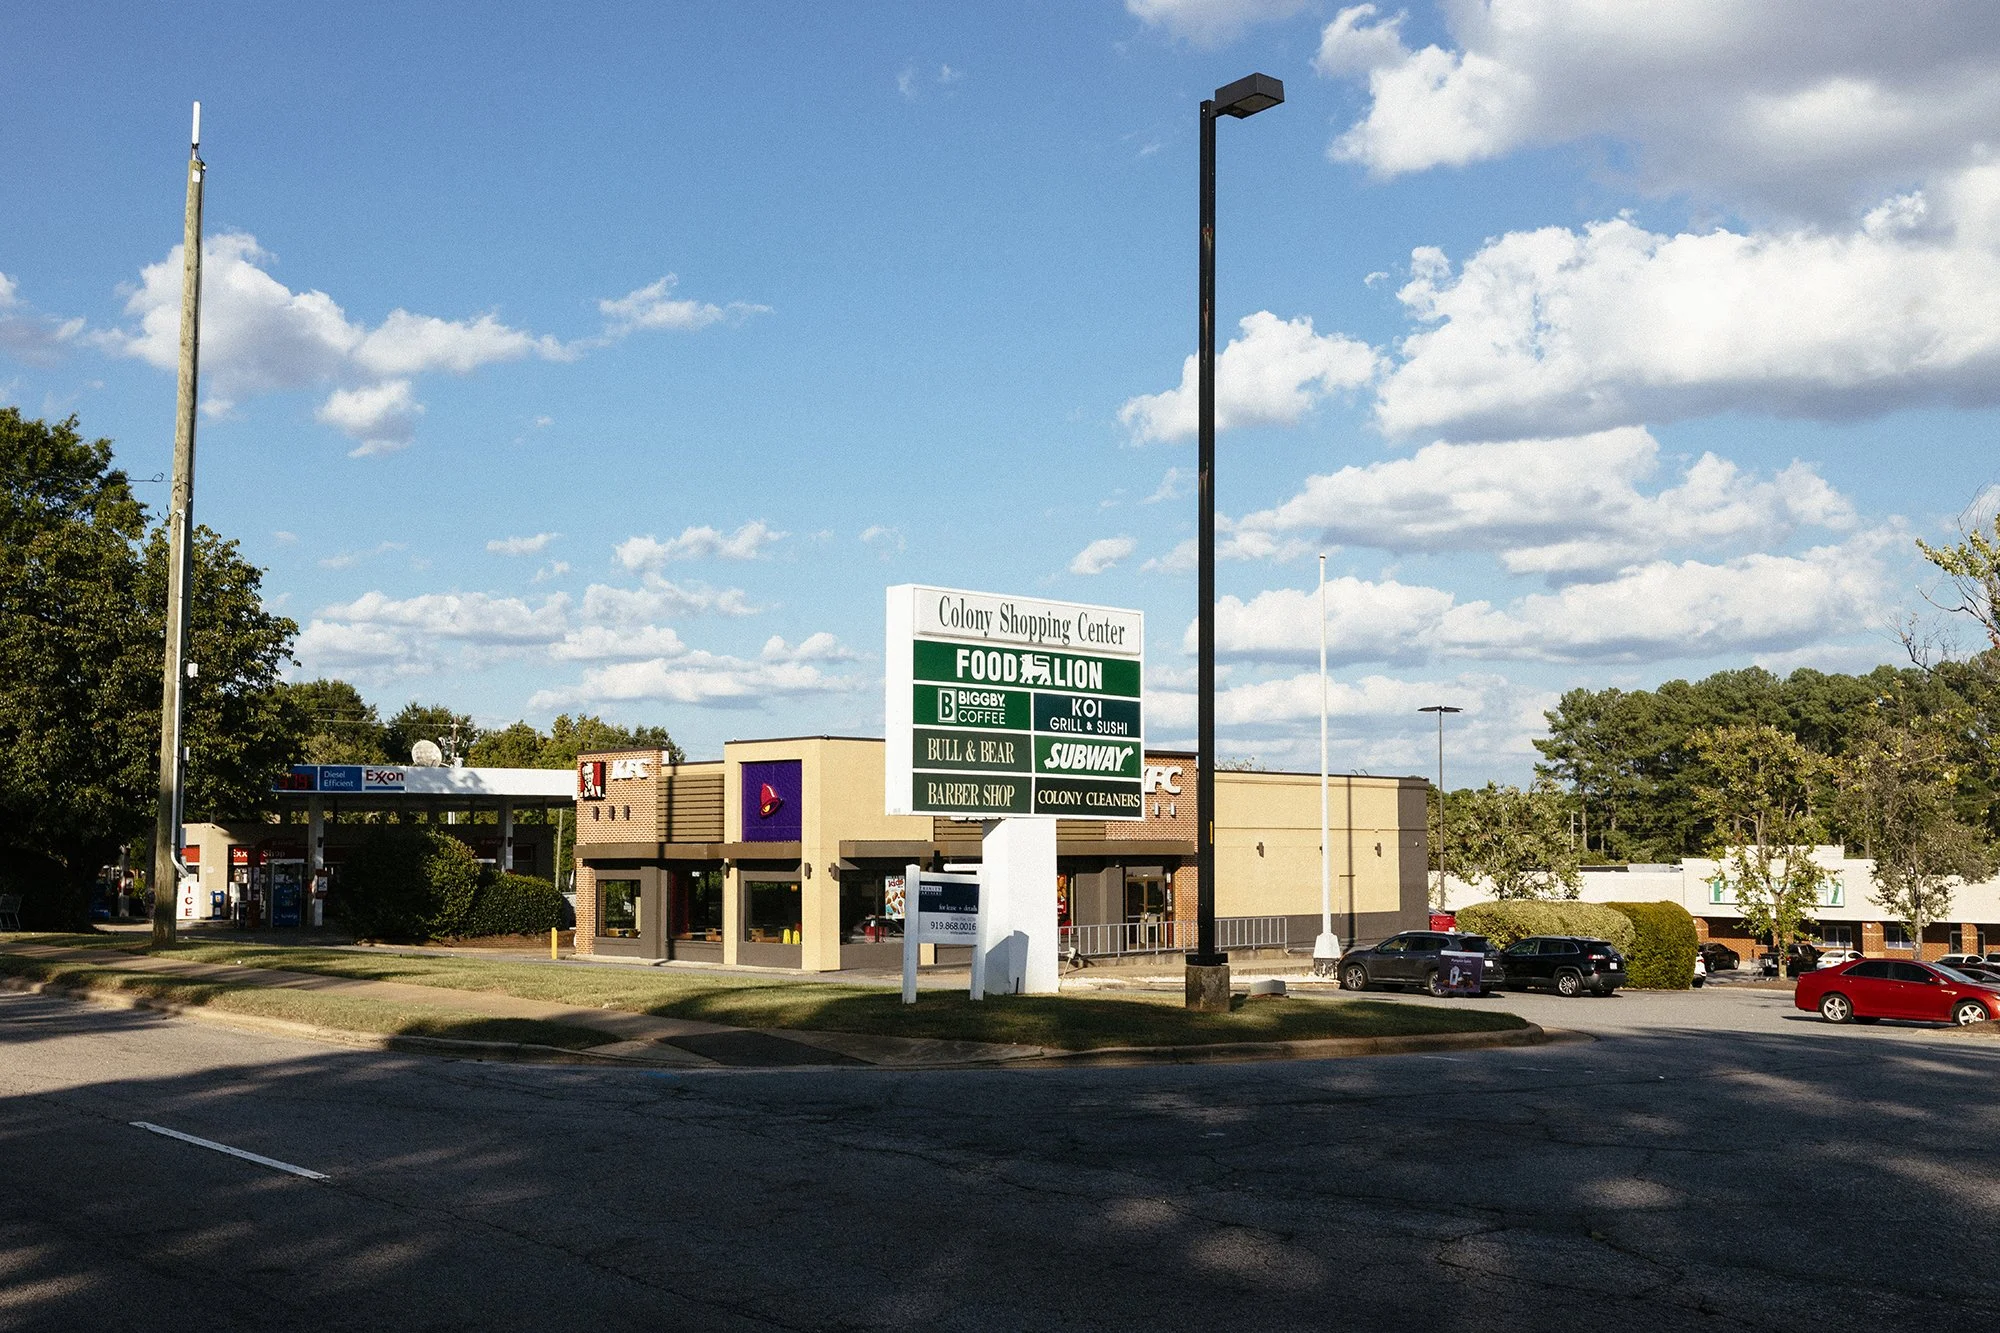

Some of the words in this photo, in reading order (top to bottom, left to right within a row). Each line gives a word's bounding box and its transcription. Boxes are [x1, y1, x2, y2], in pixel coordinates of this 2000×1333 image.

[939, 595, 993, 638] Colony
[1000, 602, 1072, 645] Shopping
[1078, 611, 1125, 646] Center
[956, 648, 1018, 682] FOOD
[1054, 658, 1103, 690] LION
[958, 710, 1006, 725] COFFEE
[1072, 698, 1102, 719] KOI
[1050, 717, 1083, 732] GRILL
[1086, 721, 1093, 731] &
[1097, 720, 1128, 735] SUSHI
[928, 737, 962, 761] BULL
[966, 739, 976, 762] &
[980, 740, 1015, 764] BEAR
[1043, 743, 1134, 772] SUBWAY
[323, 770, 346, 779] Diesel
[323, 780, 354, 788] Efficient
[365, 769, 405, 785] Exxon
[927, 782, 979, 806] BARBER
[983, 784, 1015, 807] SHOP
[1037, 789, 1083, 806] COLONY
[1086, 791, 1141, 808] CLEANERS
[184, 885, 193, 917] ICE
[930, 921, 977, 931] 919.868.0016
